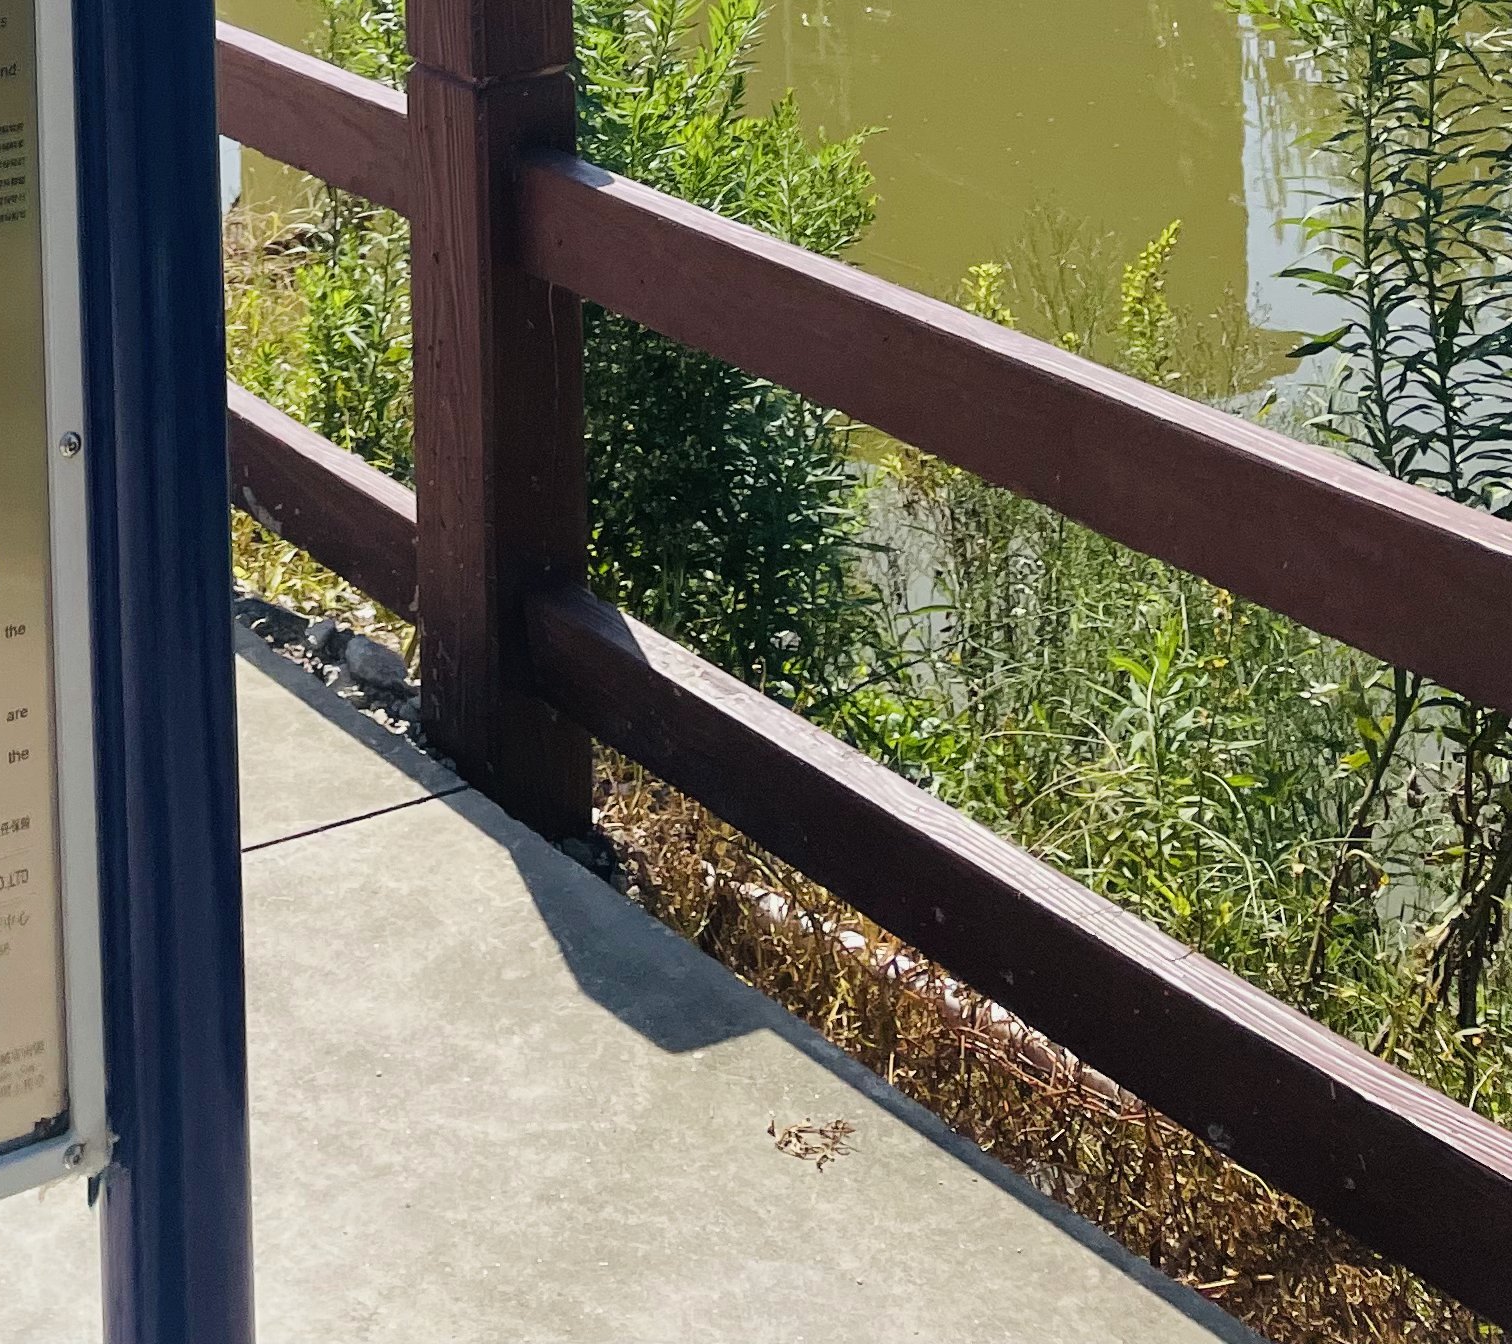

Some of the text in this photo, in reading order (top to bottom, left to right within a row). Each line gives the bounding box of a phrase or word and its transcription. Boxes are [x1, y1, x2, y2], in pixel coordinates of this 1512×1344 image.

[4, 623, 26, 639] the
[6, 706, 29, 723] are
[8, 747, 30, 765] the
